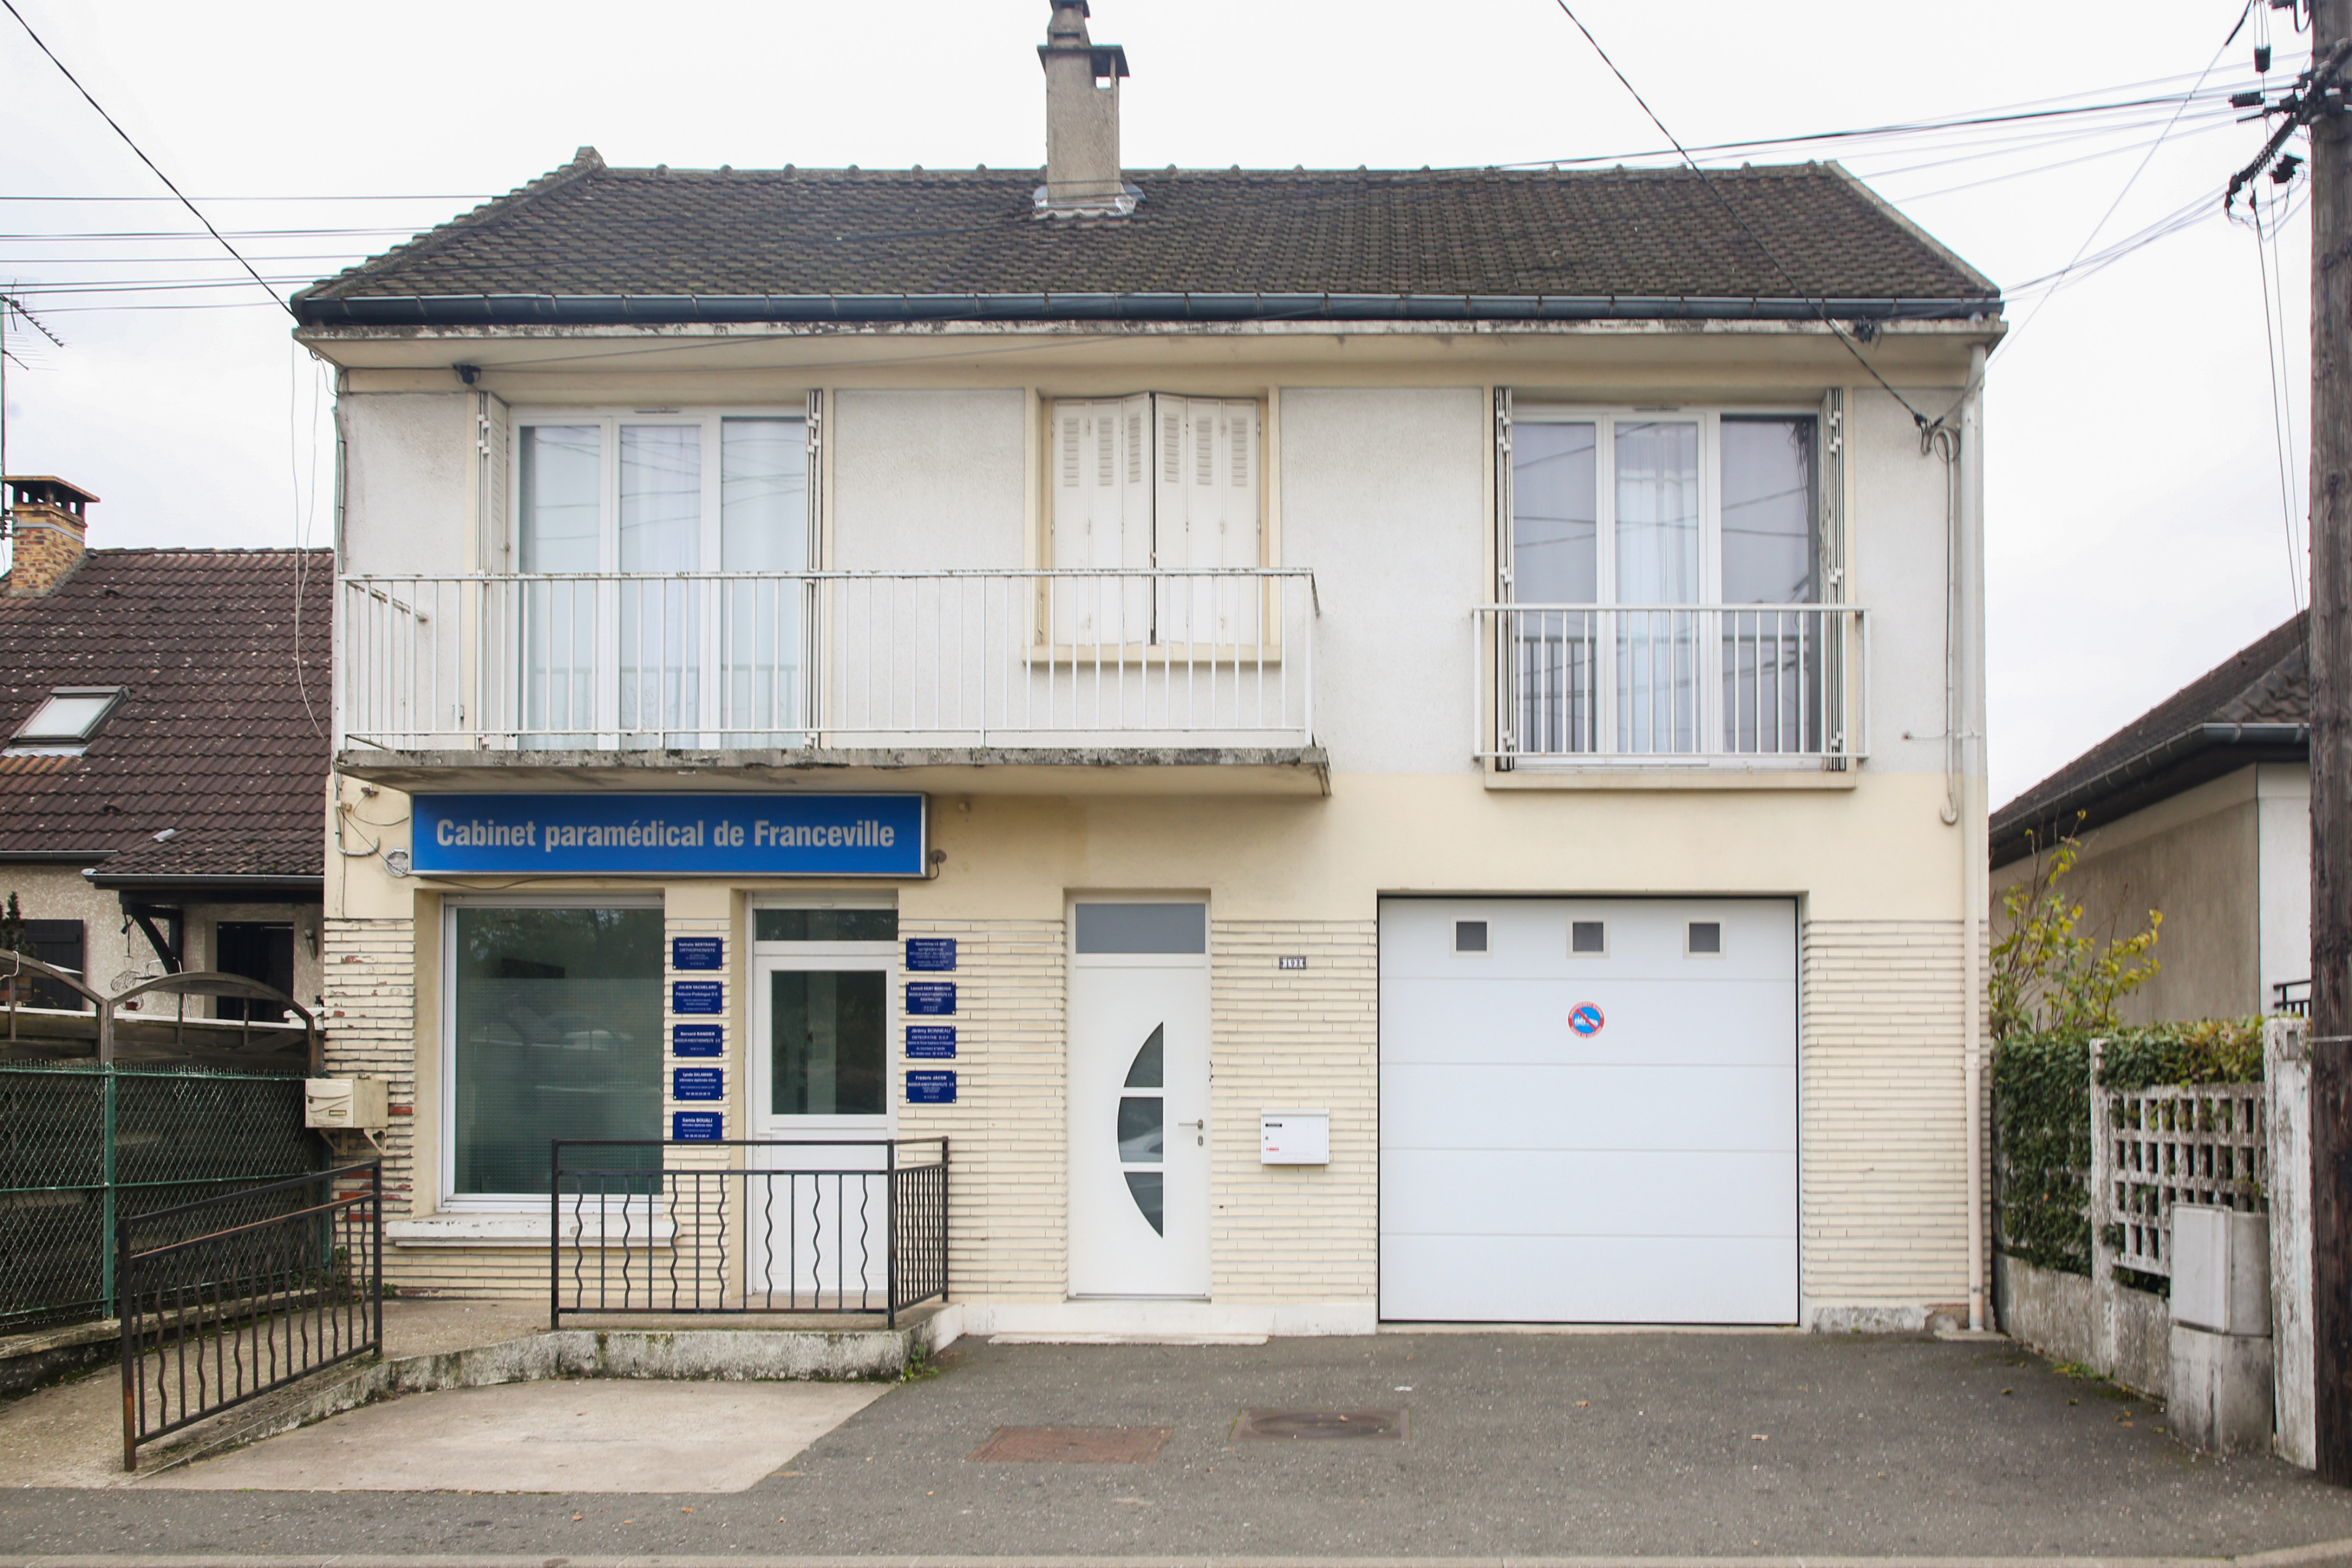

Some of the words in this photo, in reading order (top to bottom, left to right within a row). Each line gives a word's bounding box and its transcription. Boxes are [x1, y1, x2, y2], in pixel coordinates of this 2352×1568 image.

[437, 820, 536, 846] Cabinet
[545, 820, 703, 852] paramédical
[714, 821, 744, 846] de
[755, 821, 894, 846] Franceville
